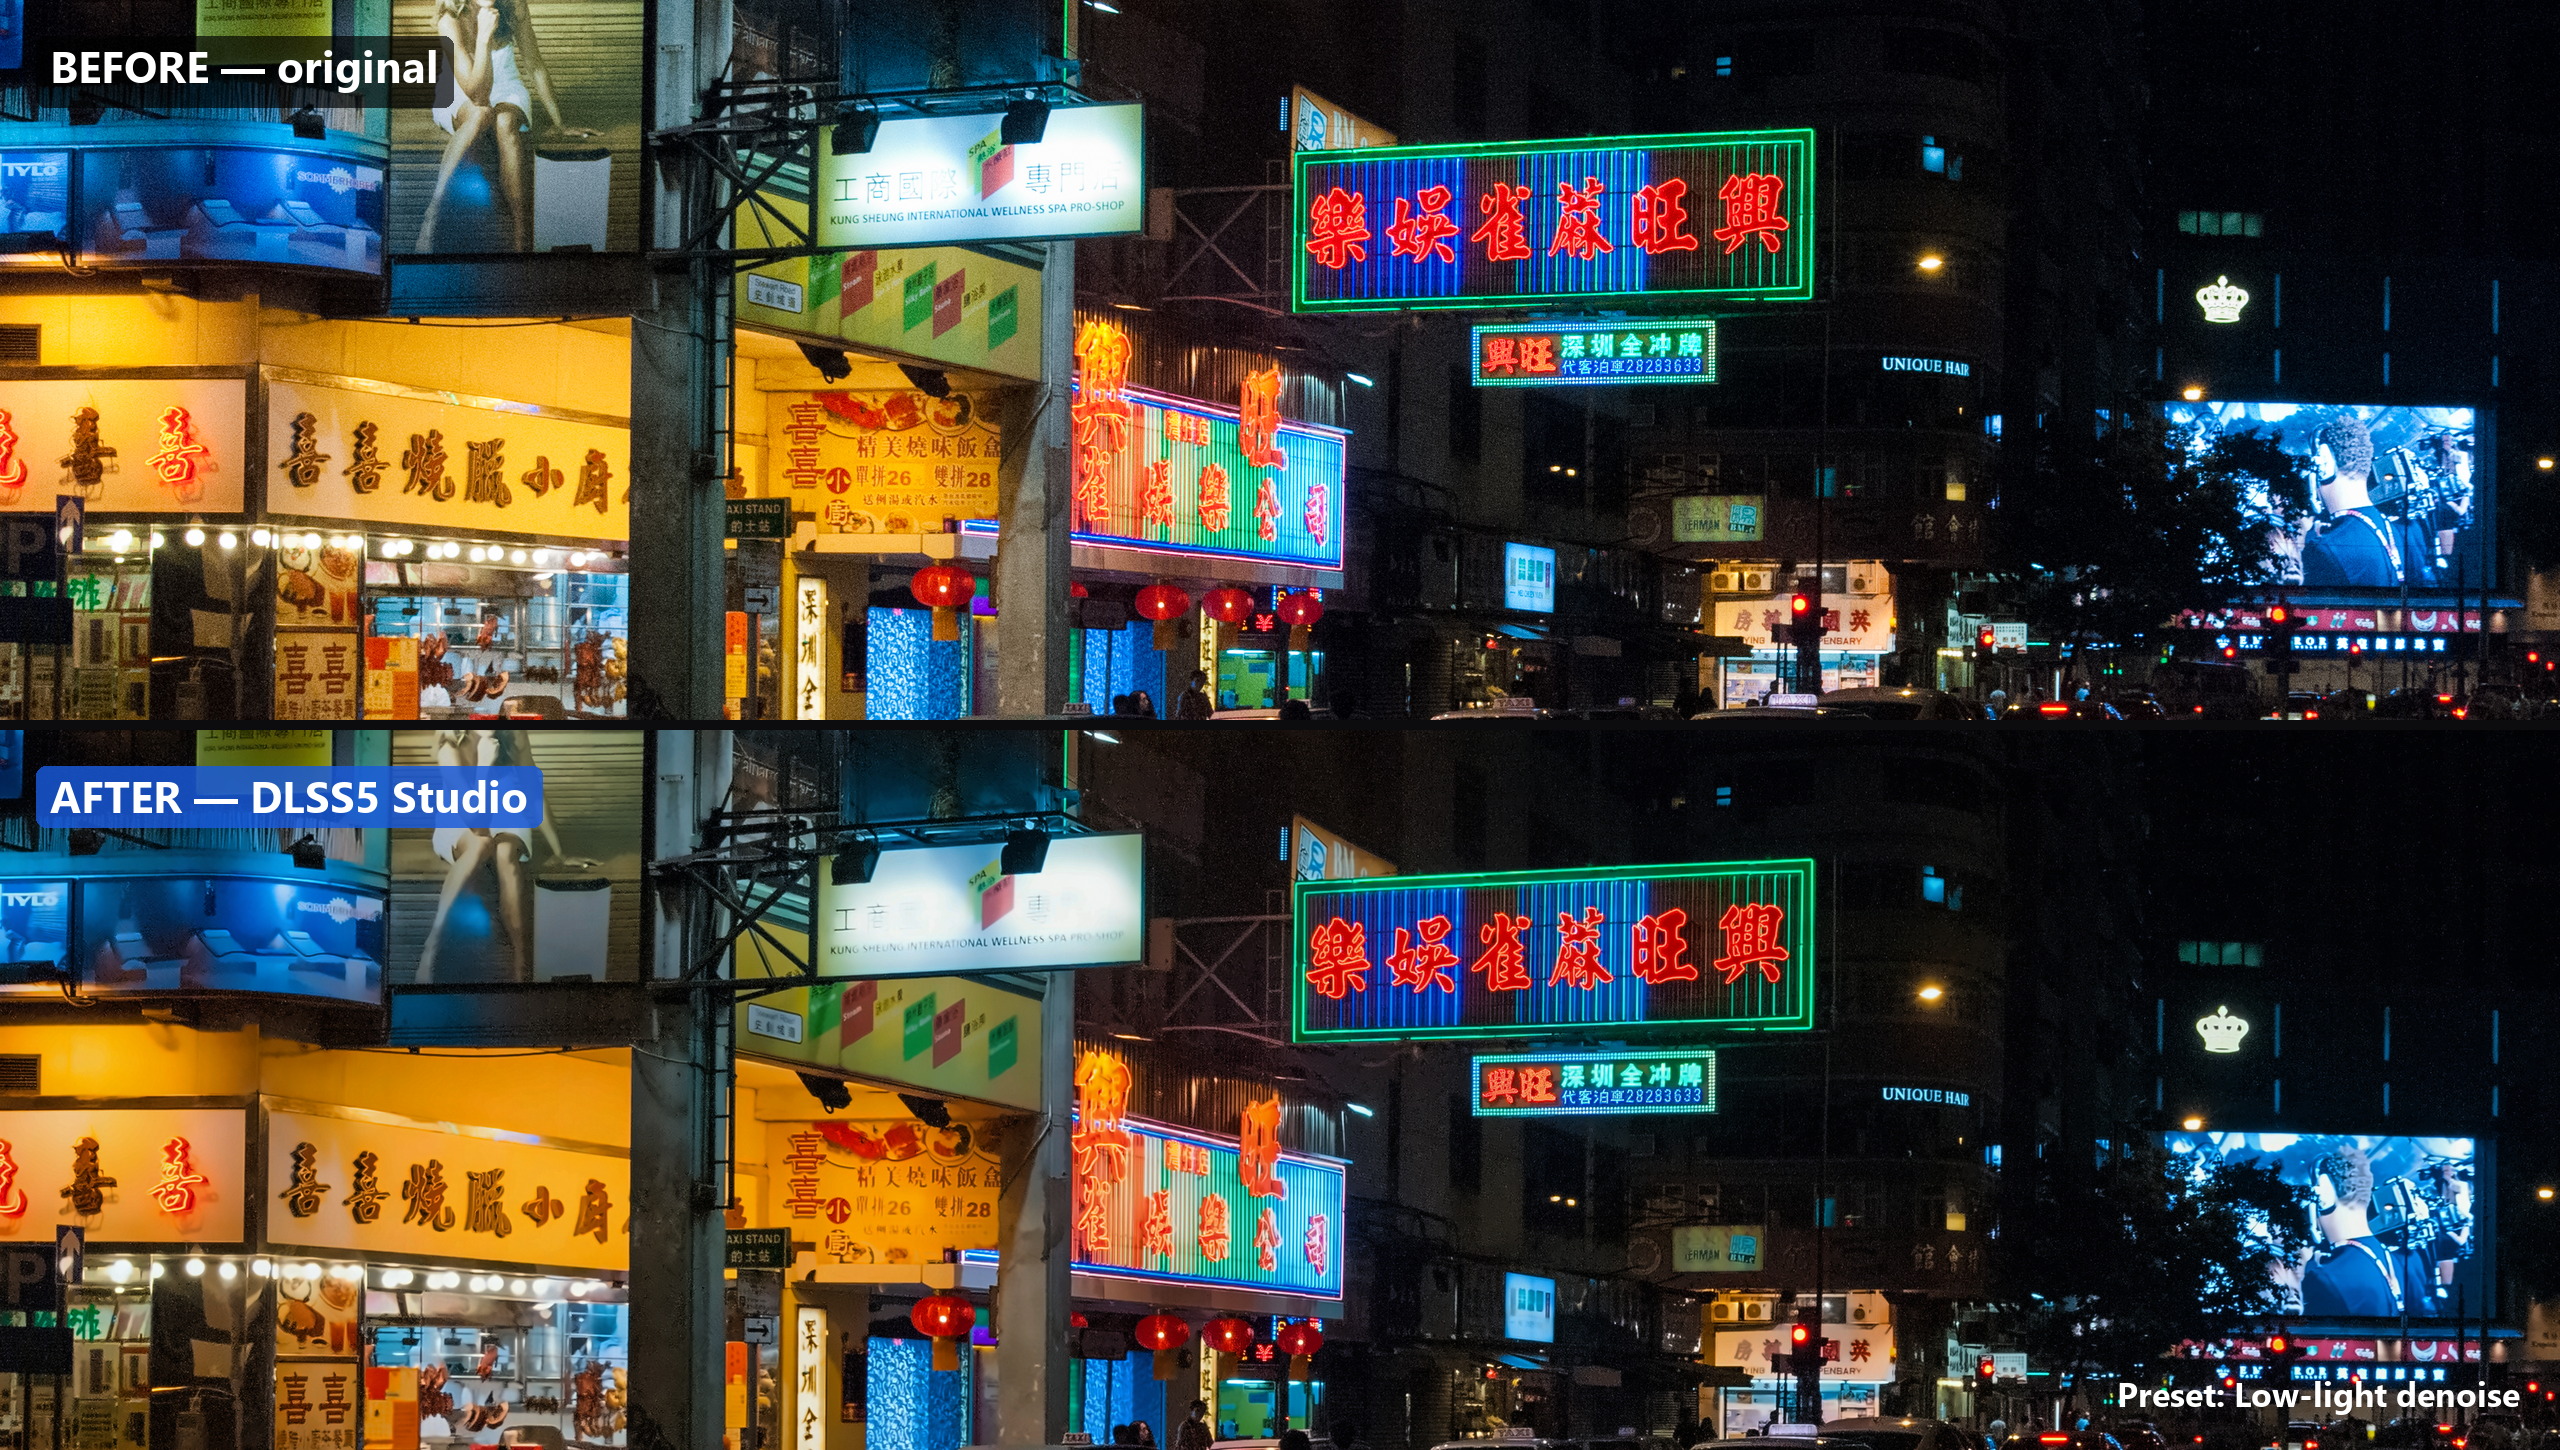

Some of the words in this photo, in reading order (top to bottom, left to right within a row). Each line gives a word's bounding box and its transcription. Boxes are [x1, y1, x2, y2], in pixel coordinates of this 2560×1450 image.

[968, 140, 987, 158] SPA
[830, 215, 859, 225] KUNG
[862, 212, 904, 224] SHEUNG
[907, 208, 988, 221] INTERNATIONAL
[992, 204, 1045, 217] WELLNESS
[1048, 203, 1067, 214] SPA
[1070, 200, 1125, 212] PRO-SHOP
[1482, 337, 1557, 374] 興旺
[1882, 356, 1942, 373] UNIQUE
[1945, 360, 1970, 377] HAIR
[727, 504, 743, 514] AXI
[745, 504, 781, 514] STAND
[731, 519, 771, 533] 的士站
[9, 522, 47, 574] P
[279, 641, 353, 695] 喜喜
[1066, 703, 1089, 714] TAXI
[1498, 698, 1531, 708] TAXI
[1771, 694, 1814, 705] TAXI
[968, 870, 987, 888] SPA
[830, 945, 859, 955] KUNG
[907, 938, 988, 951] INTERNATIONAL
[992, 934, 1045, 947] WELLNESS
[1048, 933, 1067, 944] SPA
[1482, 1067, 1557, 1104] 興旺
[1882, 1086, 1942, 1103] UNIQUE
[1945, 1090, 1970, 1107] HAIR
[727, 1234, 743, 1244] AXI
[745, 1234, 781, 1244] STAND
[731, 1249, 771, 1263] 的士站
[9, 1252, 47, 1304] P
[279, 1371, 353, 1425] 喜喜
[1066, 1433, 1089, 1444] TAXI
[1498, 1428, 1531, 1438] TAXI
